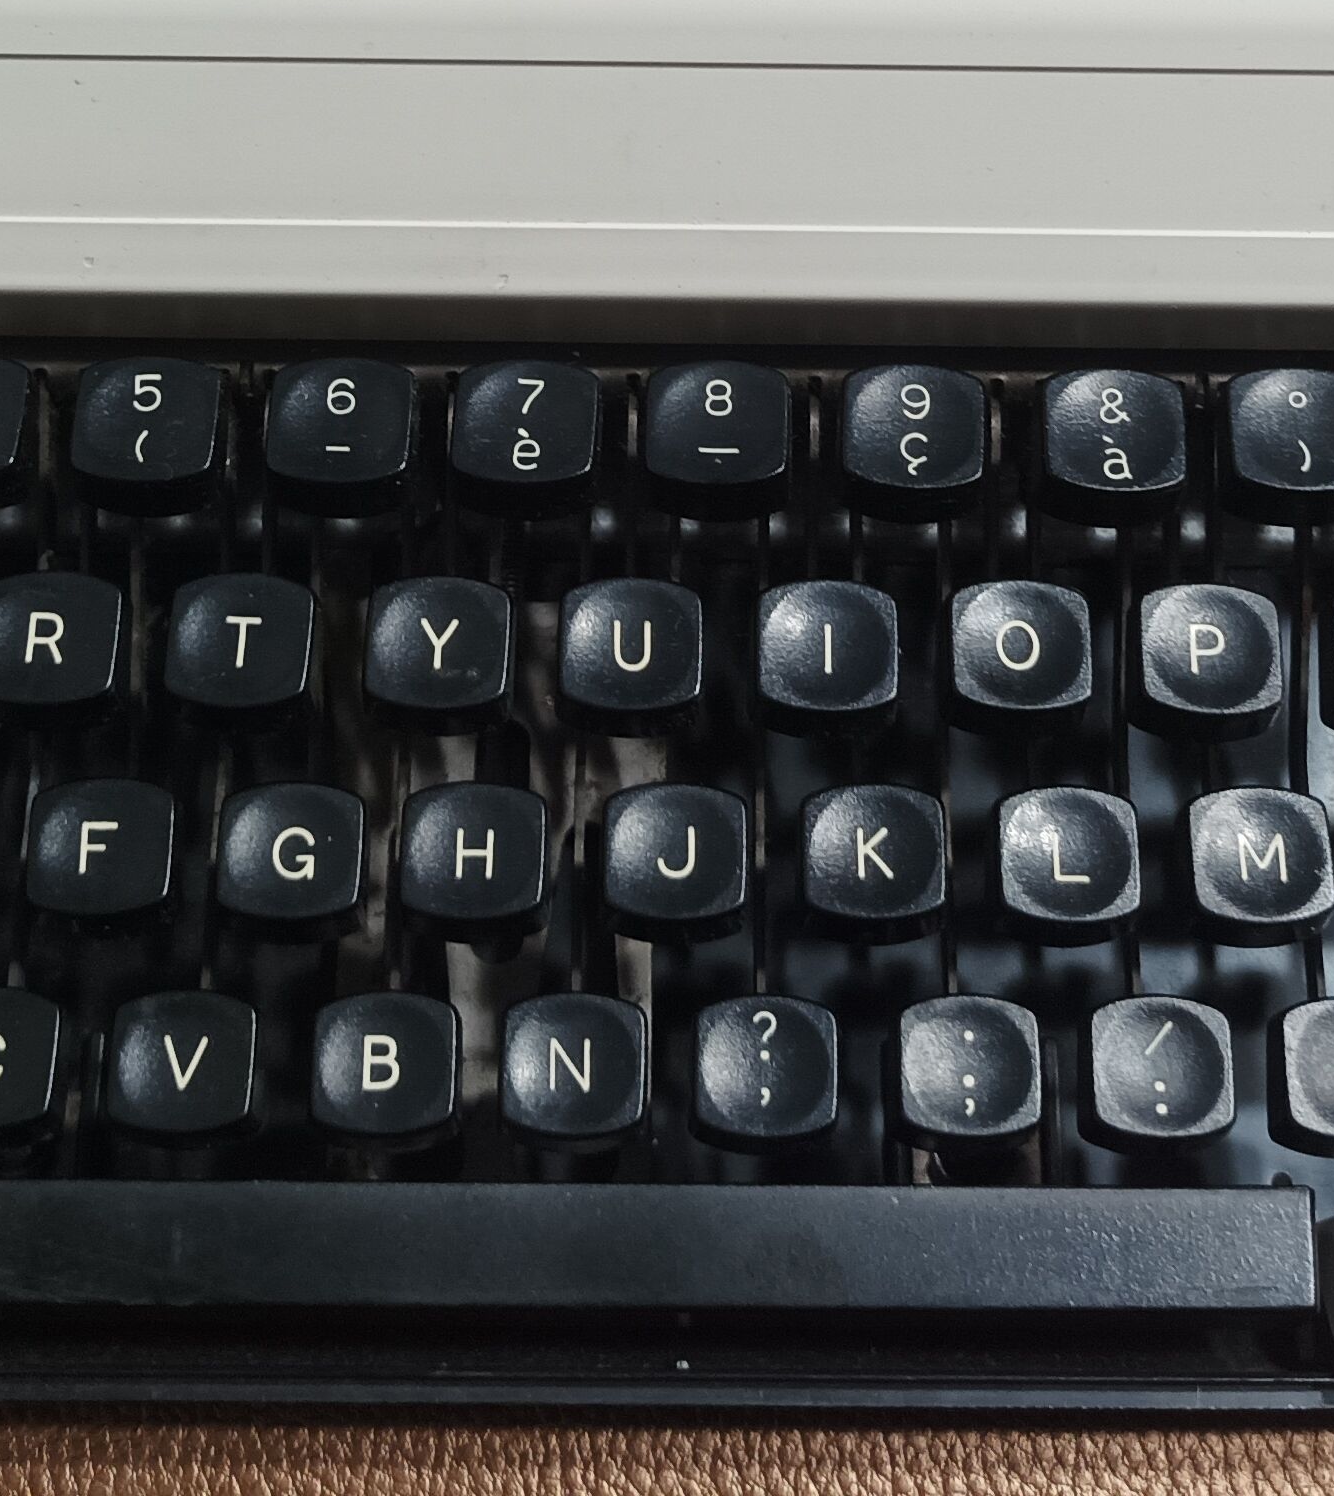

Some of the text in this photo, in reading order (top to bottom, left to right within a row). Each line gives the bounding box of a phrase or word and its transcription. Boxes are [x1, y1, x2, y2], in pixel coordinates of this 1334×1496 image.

[132, 373, 162, 412] 5
[325, 377, 356, 416] 6
[516, 377, 546, 416] 7
[704, 378, 734, 417] 8
[899, 383, 931, 420] 9
[1098, 386, 1131, 424] &
[134, 429, 149, 463] (
[511, 427, 541, 471] è
[899, 432, 928, 476] ç
[1100, 435, 1134, 481] à
[1296, 439, 1313, 472] )
[23, 610, 65, 665] R
[225, 614, 263, 669] T
[420, 617, 460, 670] Y
[612, 619, 653, 673] U
[823, 622, 833, 675] I
[994, 619, 1041, 672] O
[1188, 623, 1225, 675] P
[77, 820, 119, 875] F
[271, 825, 316, 881] G
[453, 827, 496, 880] H
[656, 825, 696, 880] J
[856, 826, 895, 881] K
[1051, 830, 1092, 885] L
[1236, 831, 1289, 885] M
[751, 1009, 778, 1062] ?
[1144, 1020, 1174, 1057] /
[162, 1033, 209, 1092] V
[360, 1033, 401, 1092] B
[548, 1036, 592, 1094] N
[962, 1073, 976, 1118] ;
[1153, 1079, 1169, 1116] :
